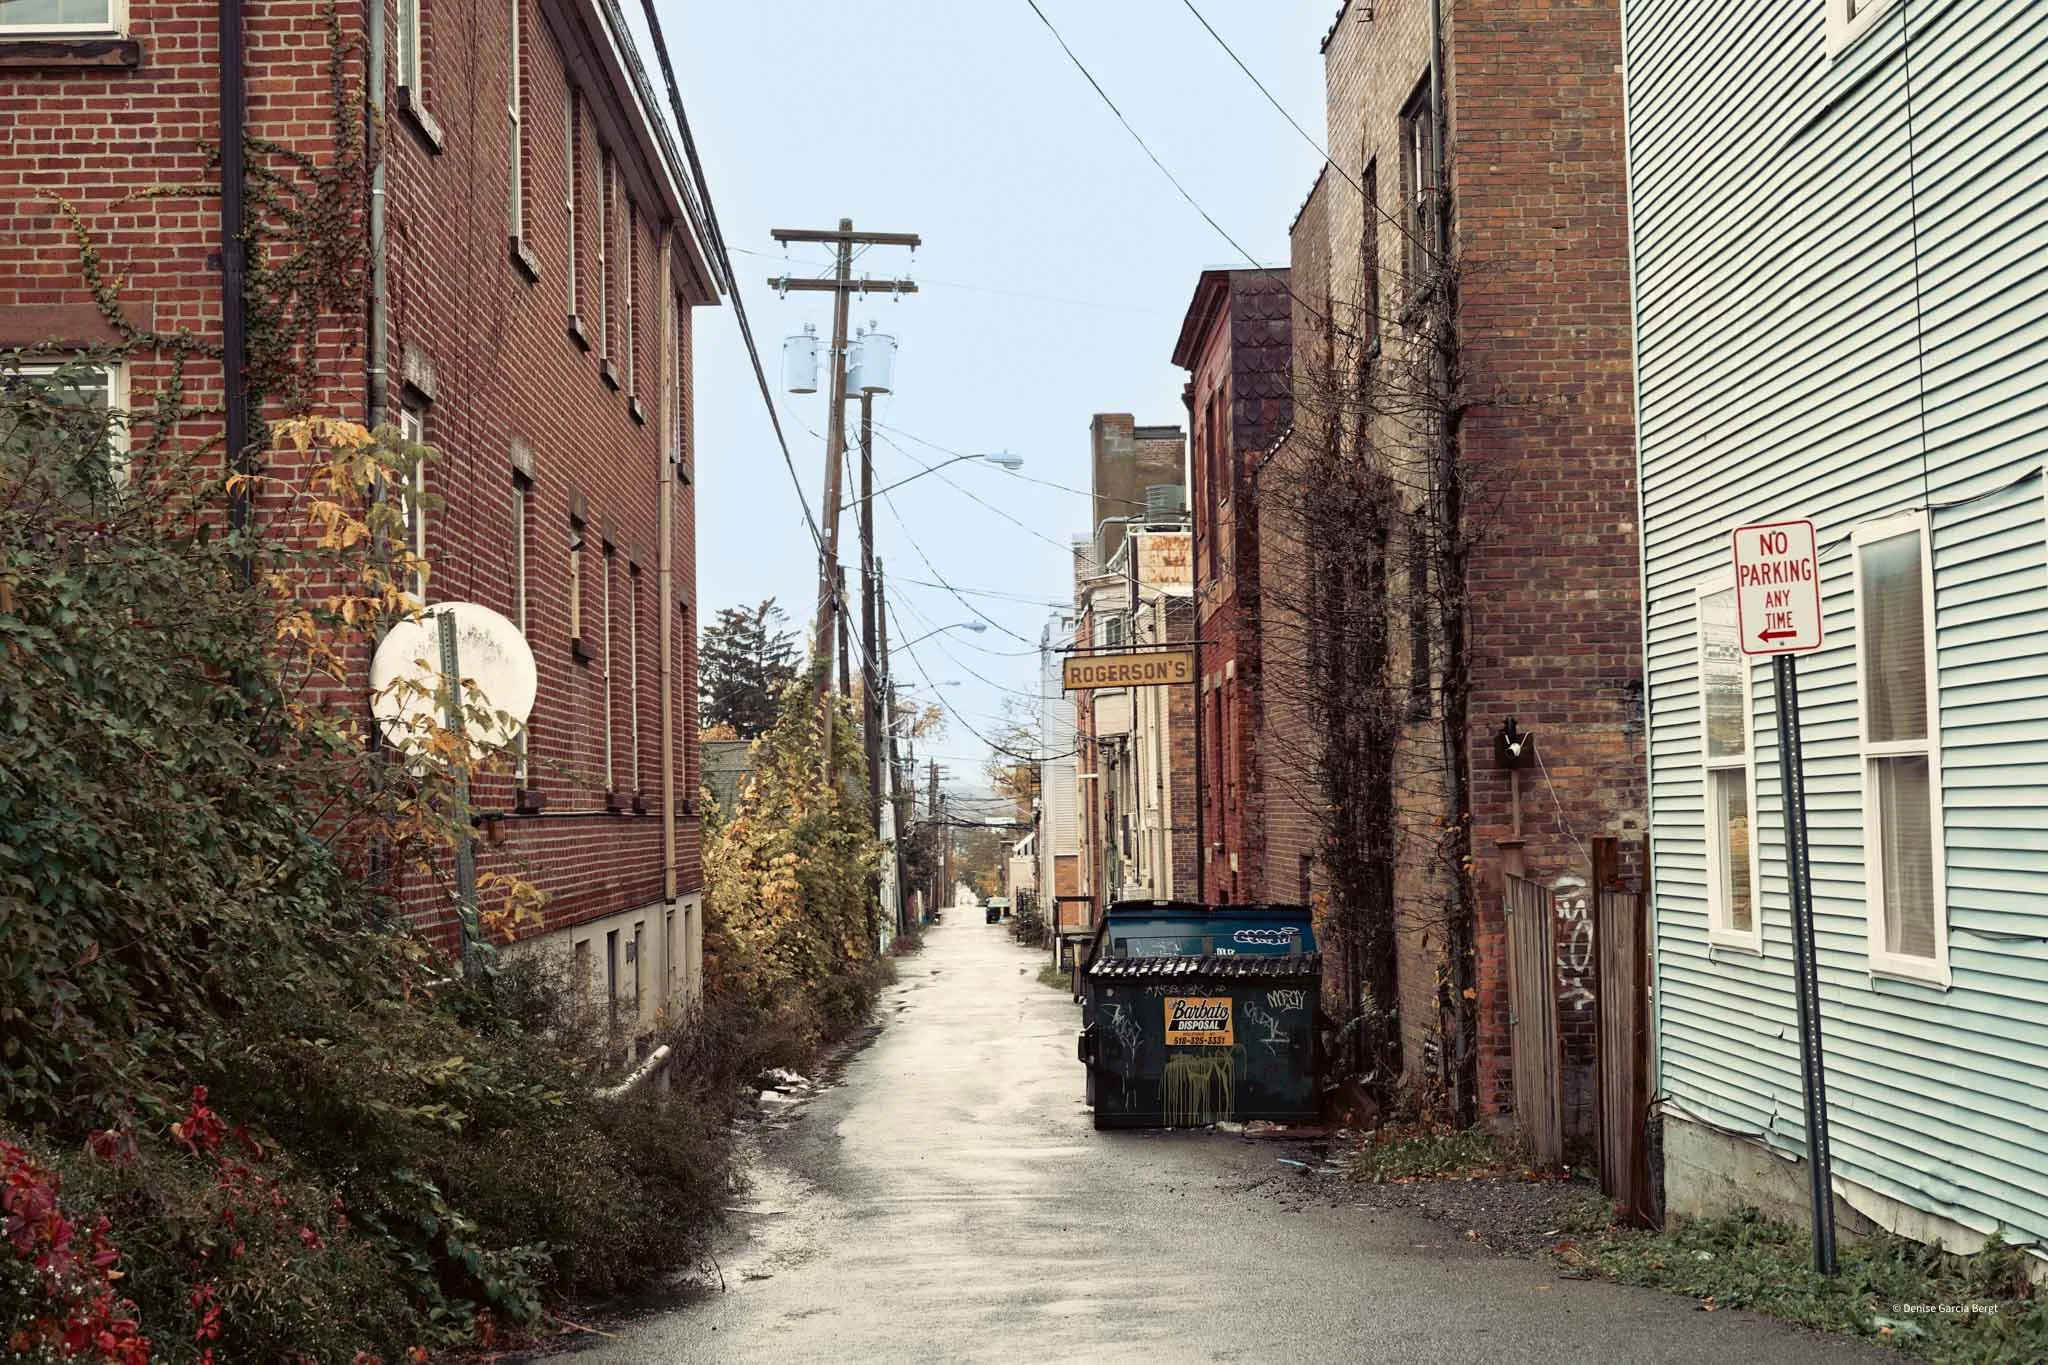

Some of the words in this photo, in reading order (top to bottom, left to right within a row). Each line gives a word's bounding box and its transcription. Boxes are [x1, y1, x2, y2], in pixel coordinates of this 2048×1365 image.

[1759, 531, 1788, 556] NO
[1740, 558, 1812, 587] PARKING
[1765, 590, 1790, 609] ANY
[1765, 611, 1794, 629] TIME
[1070, 661, 1186, 684] ROGERSON'S
[1173, 1000, 1229, 1019] Barbato
[1178, 1021, 1220, 1030] DISPOSAL
